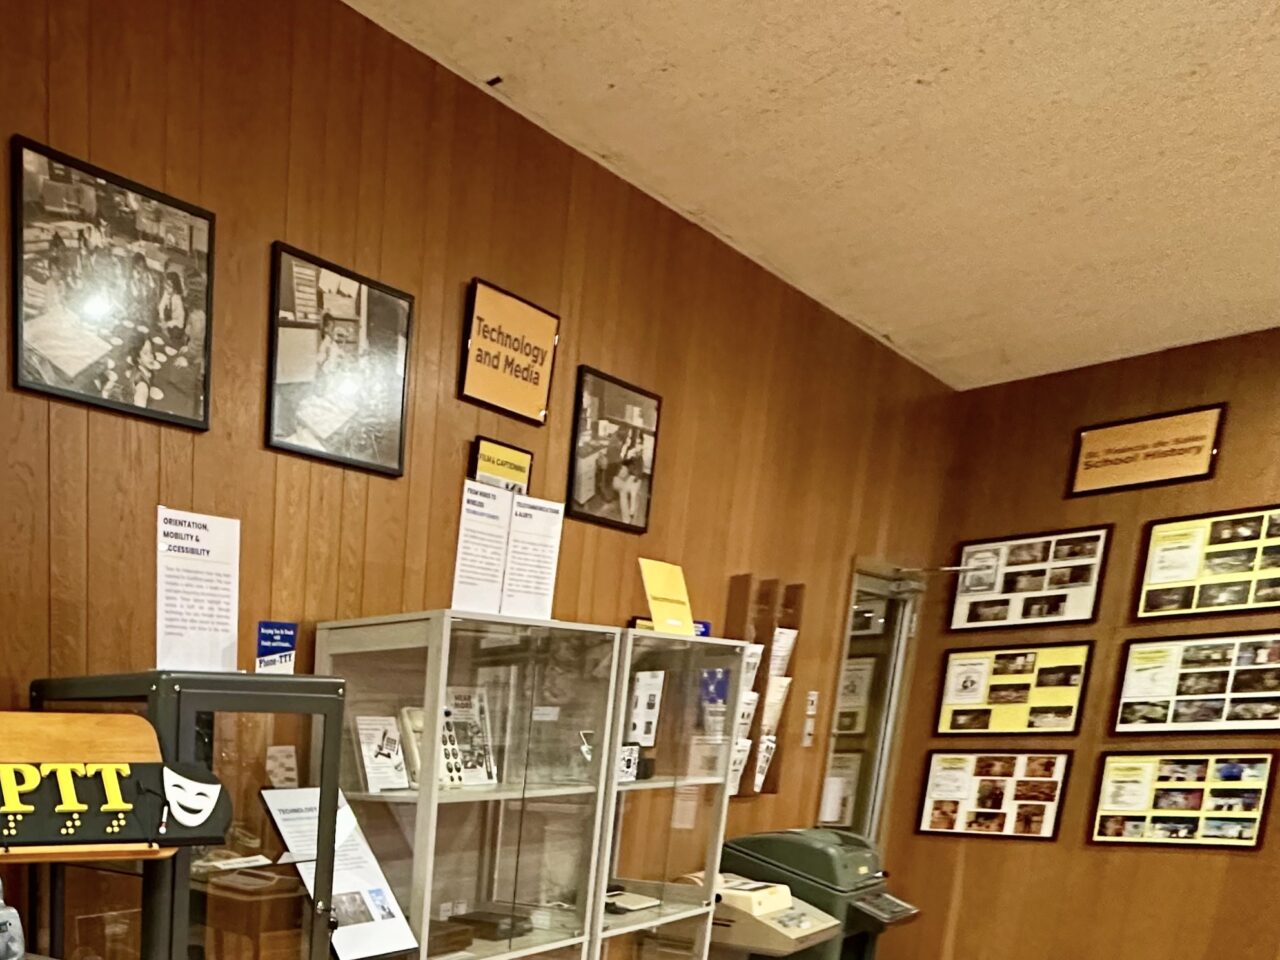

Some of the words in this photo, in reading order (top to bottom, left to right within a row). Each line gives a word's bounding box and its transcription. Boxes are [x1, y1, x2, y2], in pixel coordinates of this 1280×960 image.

[476, 316, 548, 366] Technology
[475, 347, 501, 370] and
[503, 354, 541, 386] Media
[163, 530, 194, 542] MOBILITY
[167, 544, 210, 556] CCESSIBILITY
